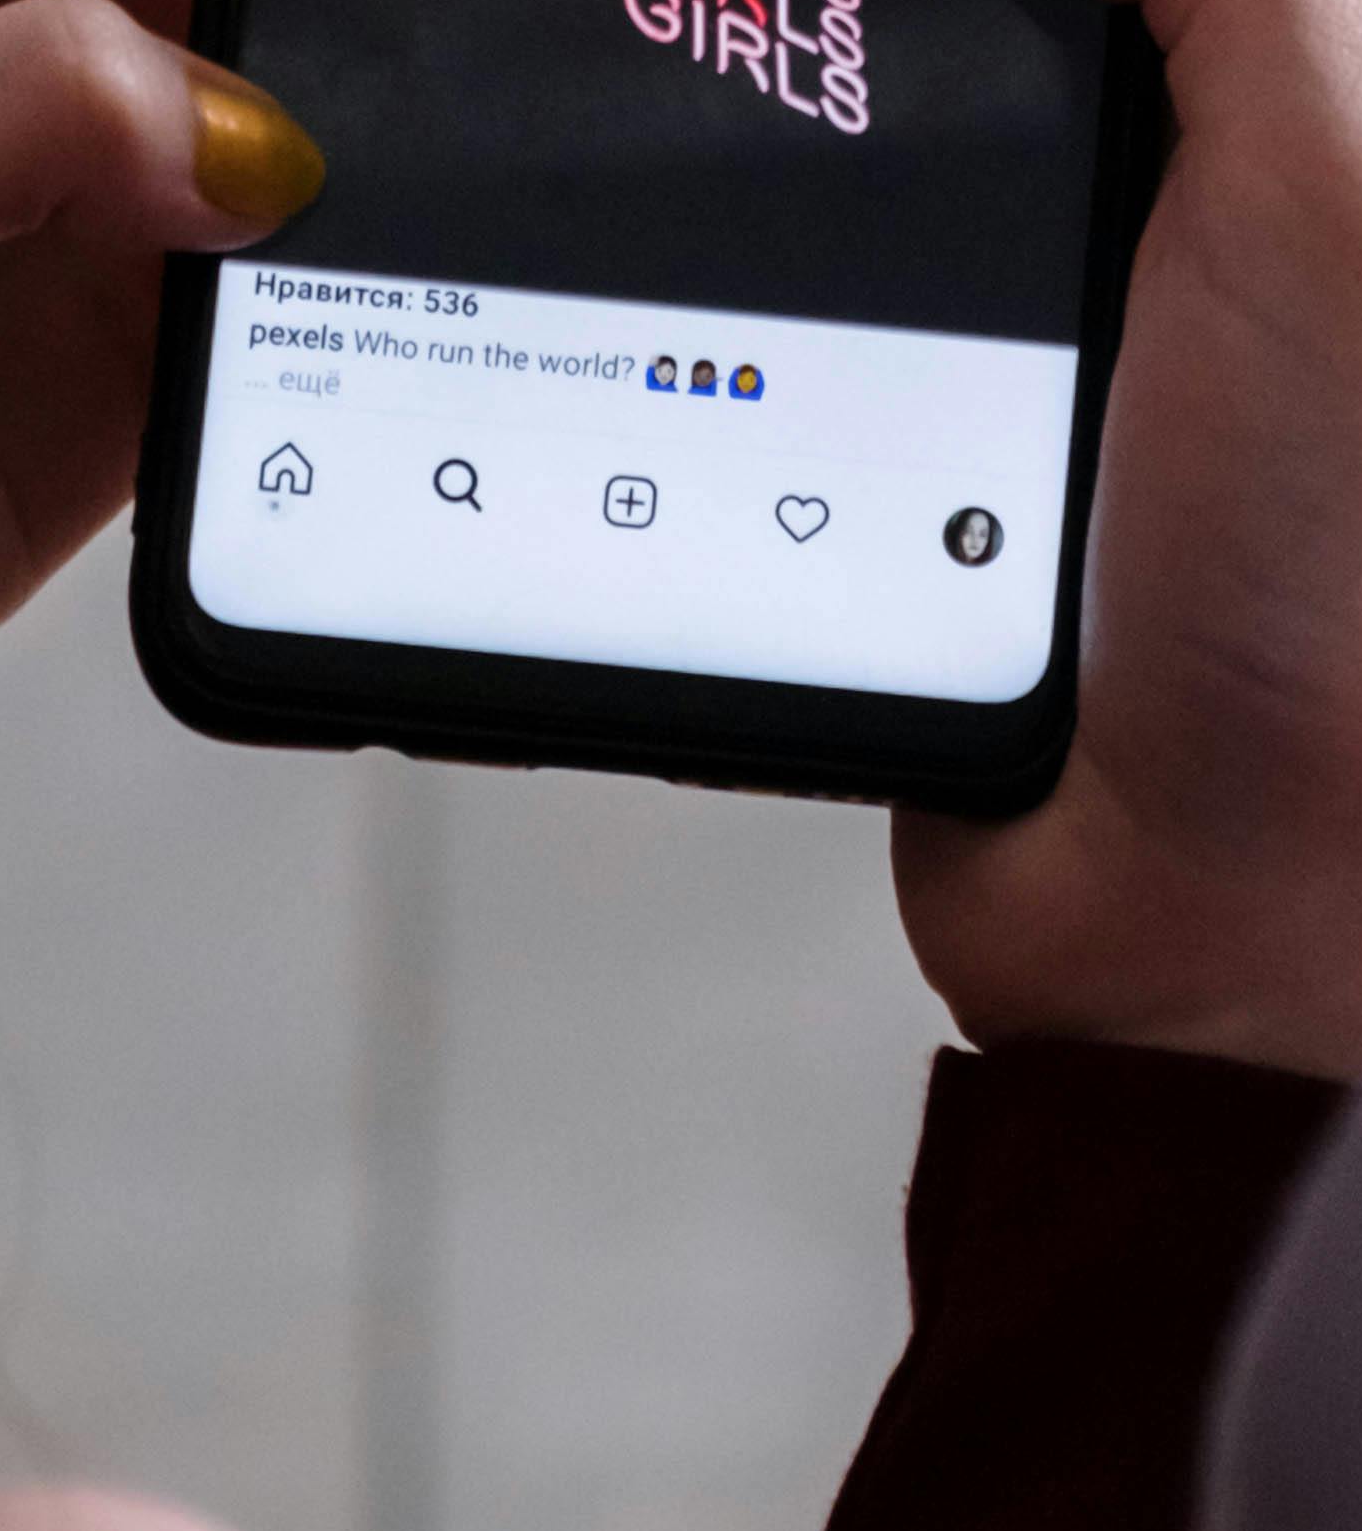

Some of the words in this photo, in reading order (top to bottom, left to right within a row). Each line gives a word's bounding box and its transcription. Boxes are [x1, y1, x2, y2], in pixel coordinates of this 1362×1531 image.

[254, 271, 414, 311] Нравится:
[423, 289, 479, 318] 536
[249, 322, 344, 353] pexels
[354, 328, 418, 360] Who
[427, 341, 473, 365] run
[483, 342, 529, 371] the
[538, 351, 636, 382] world?
[278, 370, 342, 398] ещё
